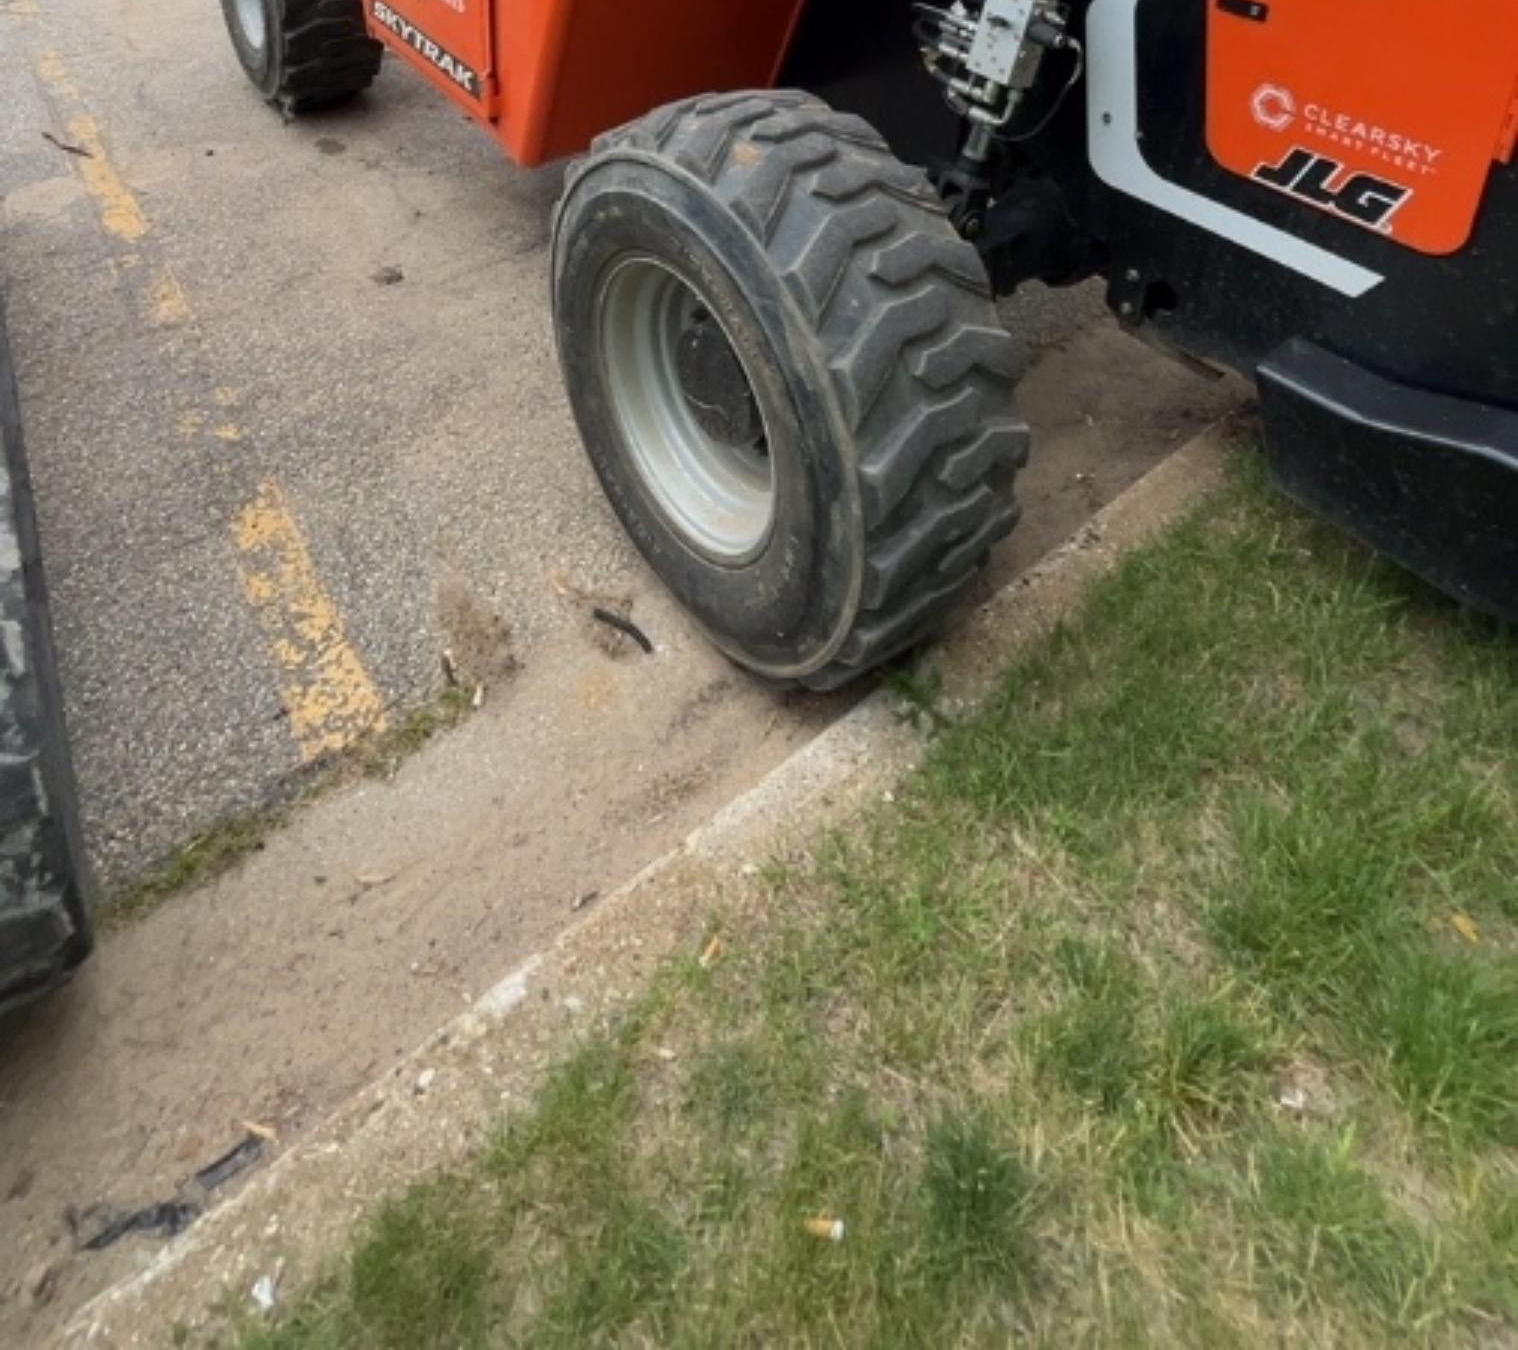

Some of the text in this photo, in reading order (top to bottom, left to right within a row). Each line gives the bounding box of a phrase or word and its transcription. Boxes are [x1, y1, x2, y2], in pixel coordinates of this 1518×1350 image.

[372, 0, 474, 91] SKYTRAK
[1303, 103, 1441, 163] CLEARSKY
[1249, 144, 1415, 231] JLG
